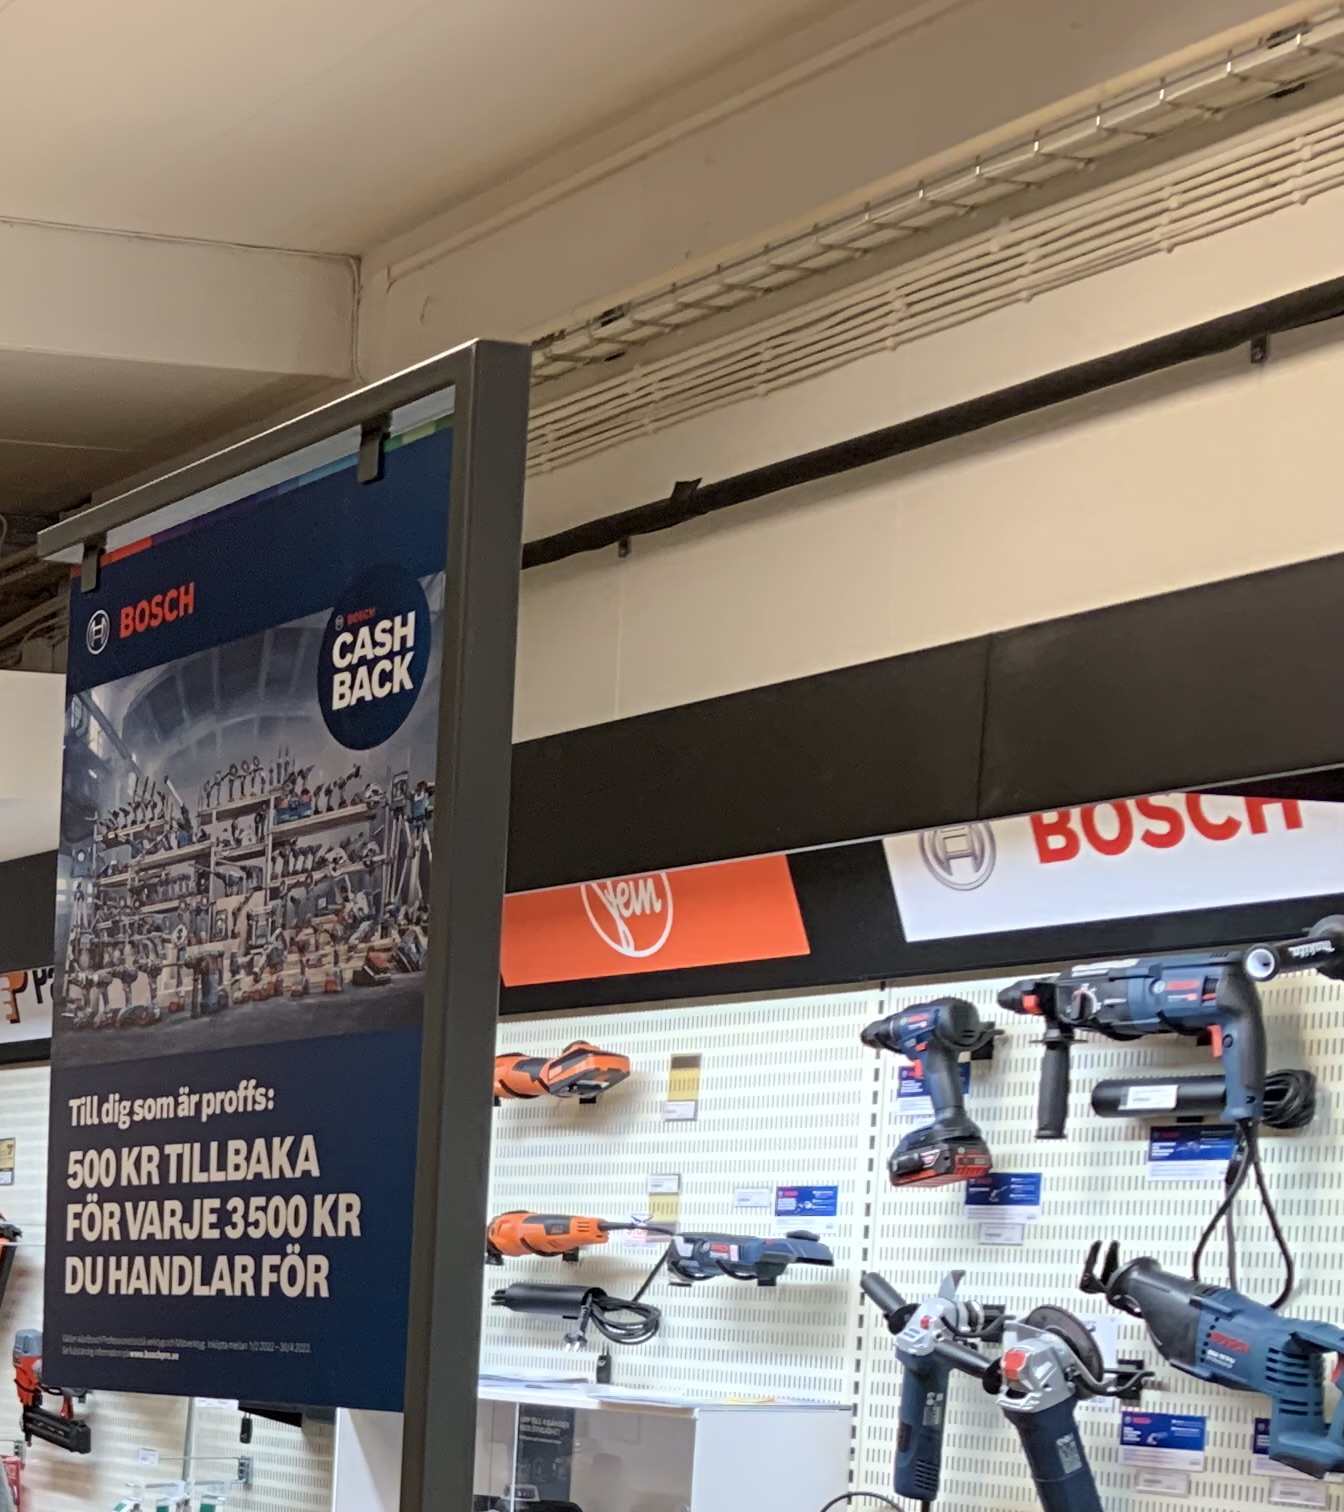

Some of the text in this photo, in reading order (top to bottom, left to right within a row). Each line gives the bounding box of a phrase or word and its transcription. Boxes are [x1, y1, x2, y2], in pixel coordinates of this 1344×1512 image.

[119, 581, 195, 639] BOSCH
[332, 610, 416, 669] CASH
[332, 651, 415, 711] BACK
[68, 1078, 275, 1130] Till dig som är proffs:
[67, 1134, 321, 1190] 500 KR TILLBAKA
[66, 1192, 362, 1242] FÖR VARJE 3500 KR
[64, 1242, 330, 1298] DU HANDLAR FÖR
